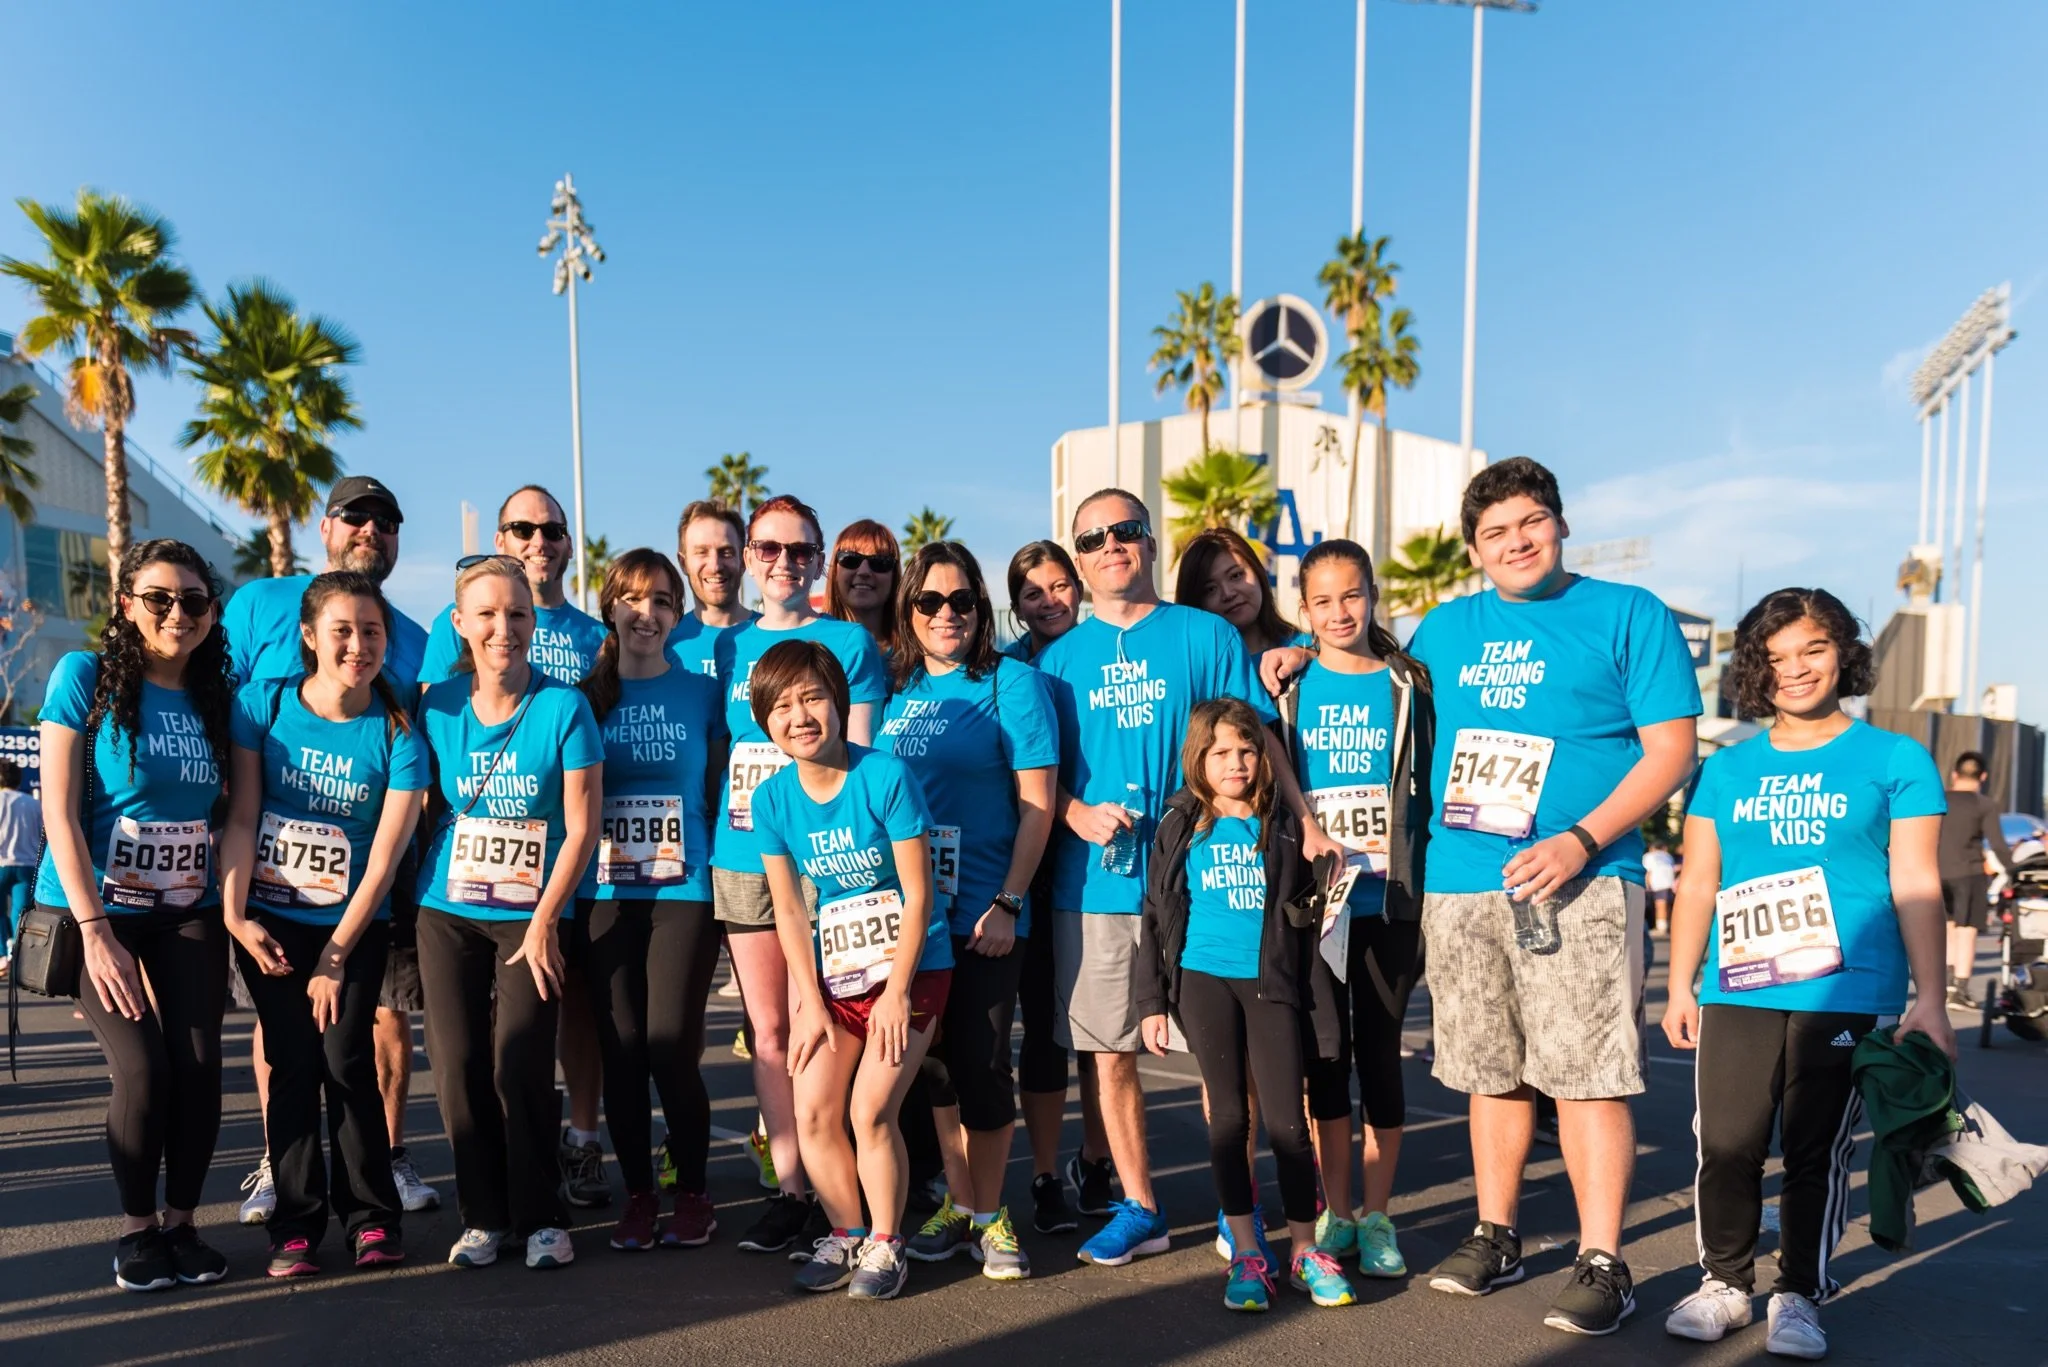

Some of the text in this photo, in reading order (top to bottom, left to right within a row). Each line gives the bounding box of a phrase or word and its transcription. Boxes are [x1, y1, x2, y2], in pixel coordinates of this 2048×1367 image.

[532, 627, 573, 649] TEAM
[1481, 640, 1533, 664] TEAM
[1100, 659, 1147, 686] TEAM
[1458, 660, 1546, 688] MENDING
[1089, 678, 1166, 711] MENDING
[1480, 685, 1527, 710] KIDS
[618, 703, 665, 725] TEAM
[901, 699, 943, 718] TEAM
[1116, 702, 1154, 729] KIDS
[1318, 704, 1370, 727] TEAM
[603, 722, 687, 744] MENDING
[880, 718, 949, 736] MENDING
[1302, 727, 1388, 751] MENDING
[631, 741, 676, 763] KIDS
[893, 736, 929, 757] KIDS
[180, 759, 219, 785] KIDS
[300, 746, 354, 780] TEAM
[468, 751, 517, 775] TEAM
[1328, 751, 1372, 774] KIDS
[1450, 751, 1541, 793] 51474
[281, 765, 370, 802] MENDING
[456, 774, 539, 798] MENDING
[1758, 772, 1824, 796] TEAM
[308, 794, 353, 817] KIDS
[485, 798, 529, 818] KIDS
[652, 799, 678, 808] 5K
[1732, 792, 1848, 823] MENDING
[182, 824, 205, 834] 5K
[278, 821, 345, 838] BIG 5K
[602, 817, 681, 843] 50388
[1312, 806, 1387, 838] 1465
[1769, 819, 1827, 846] KIDS
[455, 834, 541, 868] 50379
[807, 826, 855, 856] TEAM
[114, 839, 207, 872] 50328
[257, 833, 346, 875] 50752
[802, 846, 883, 878] MENDING
[1209, 843, 1257, 866] TEAM
[835, 870, 878, 889] KIDS
[1201, 864, 1267, 892] MENDIN
[830, 902, 862, 914] BIG
[1227, 887, 1265, 910] KIDS
[1723, 893, 1828, 945] 51066
[822, 912, 900, 956] 50326
